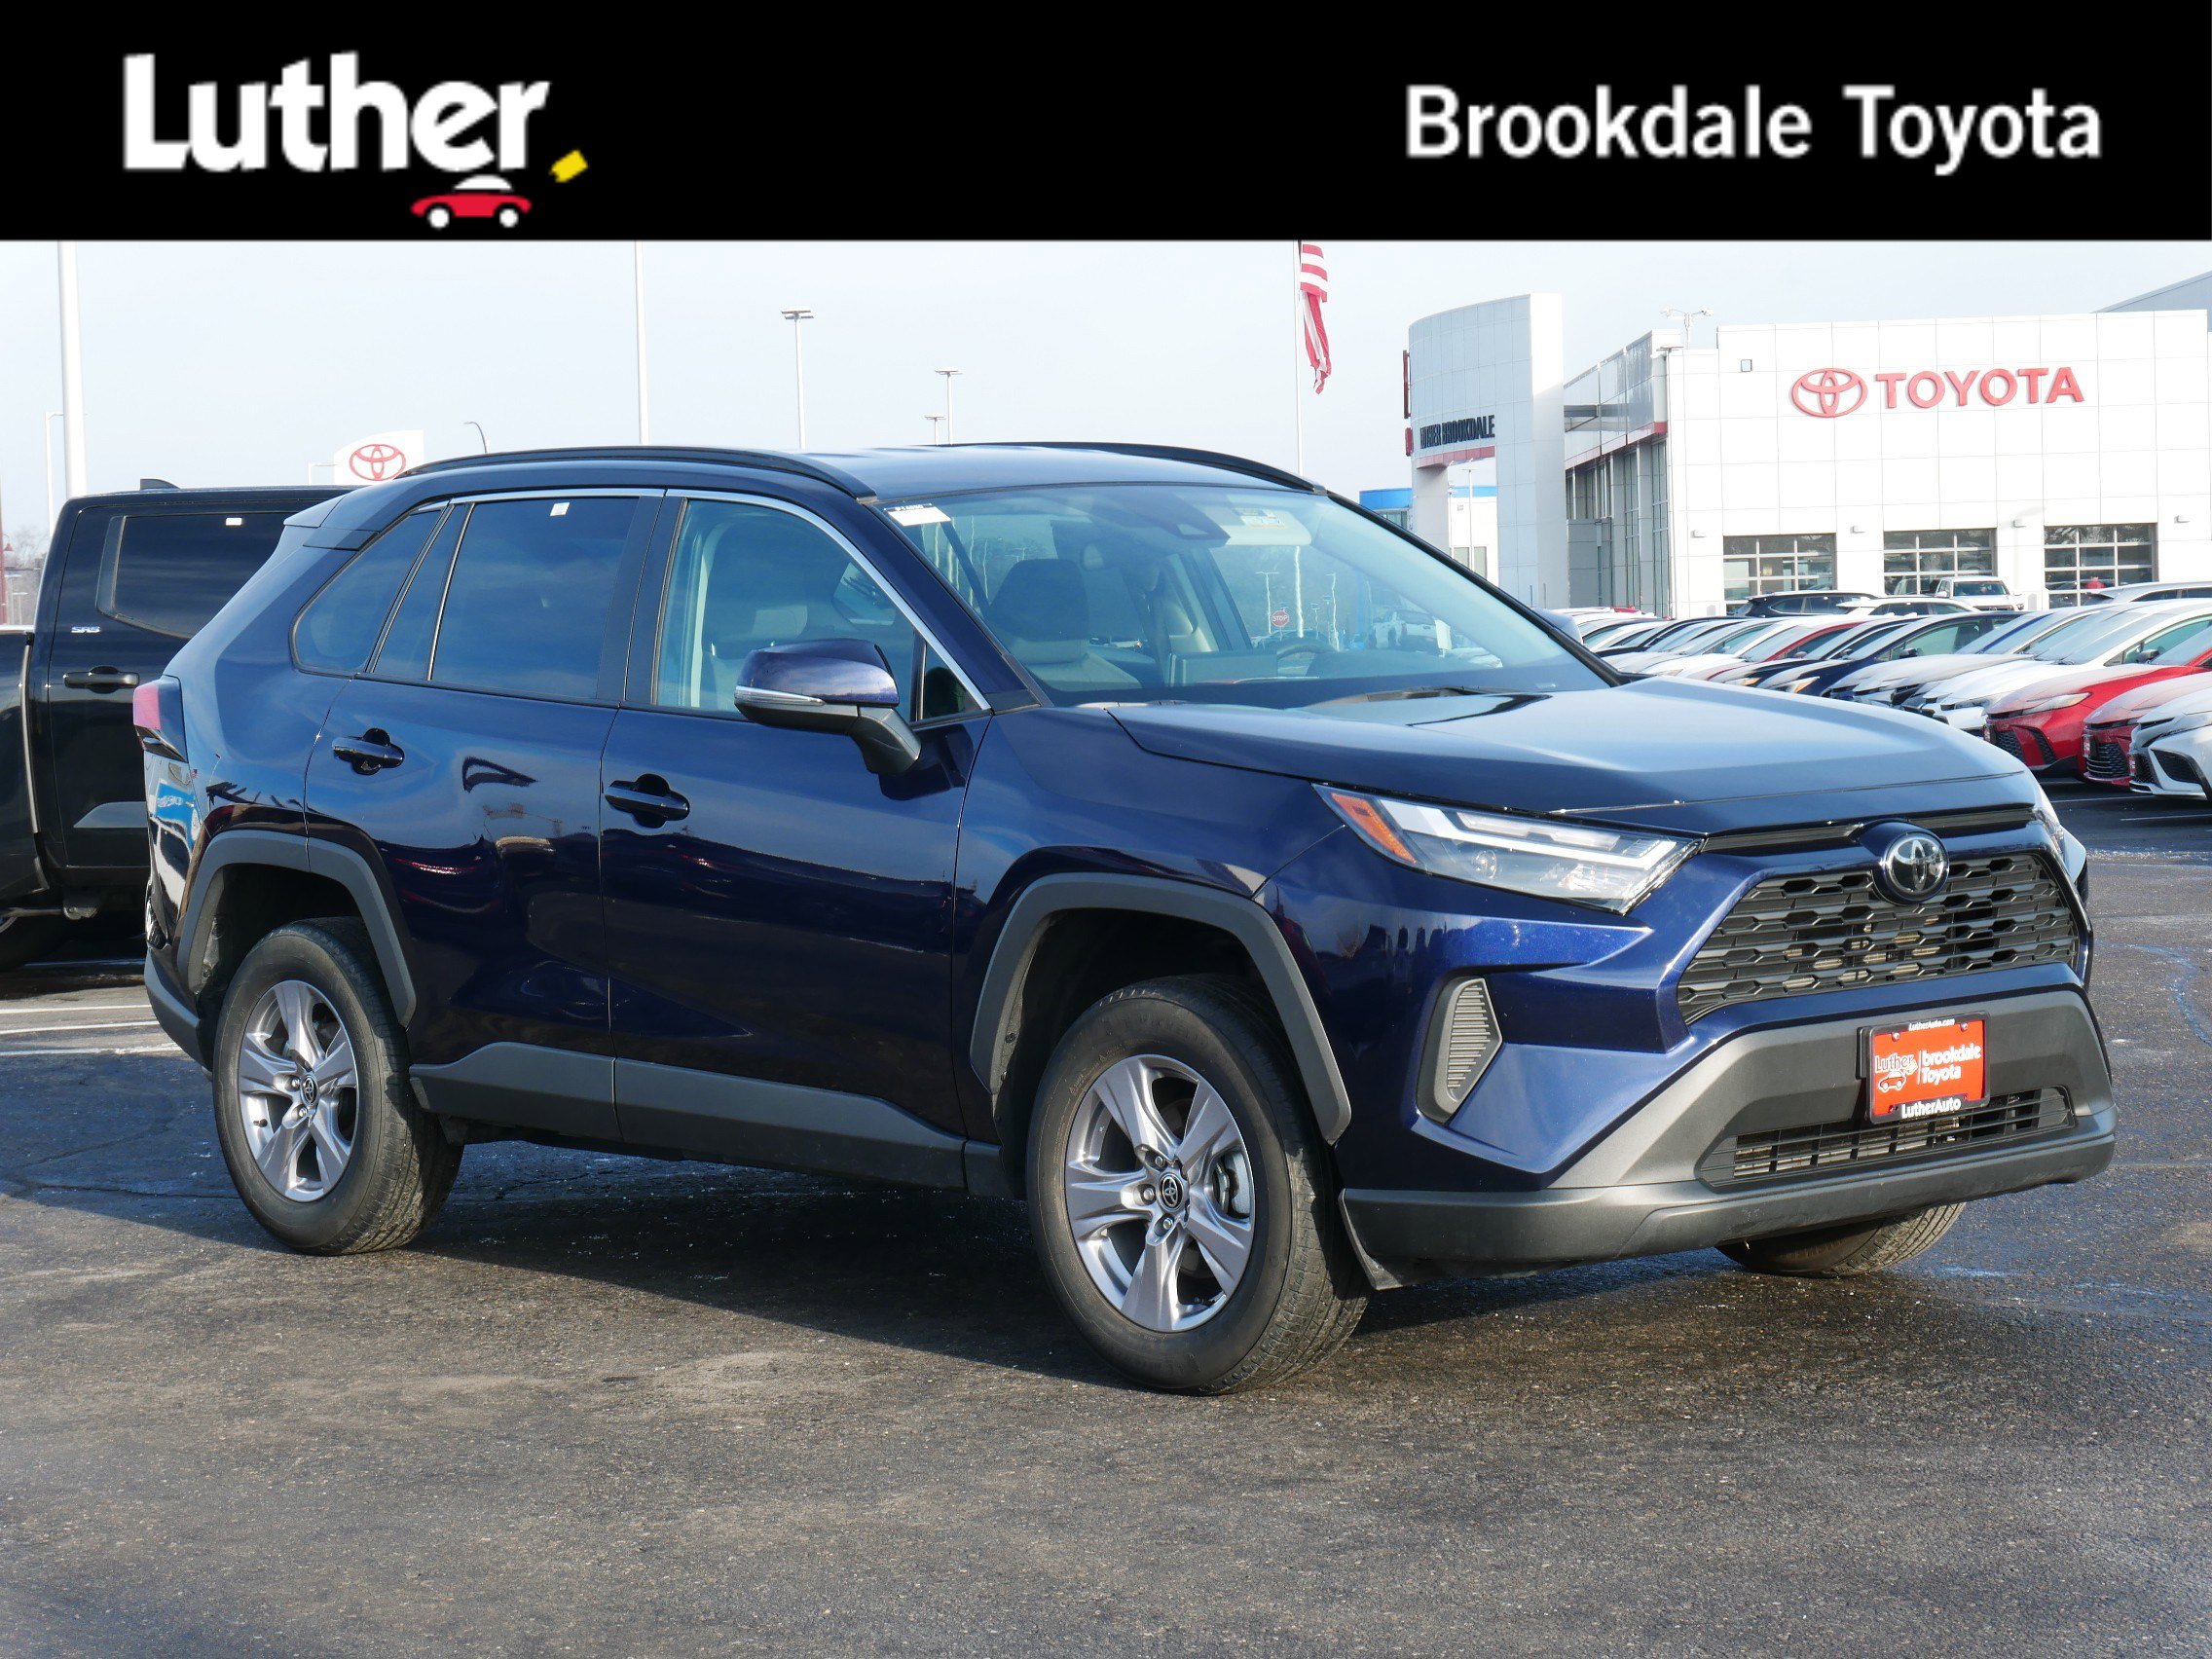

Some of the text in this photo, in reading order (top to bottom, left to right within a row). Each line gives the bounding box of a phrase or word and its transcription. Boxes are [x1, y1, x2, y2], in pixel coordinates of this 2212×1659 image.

[1875, 367, 2084, 409] TOYOTA
[1442, 415, 1494, 444] BROOKDALE
[1908, 1018, 1955, 1032] LutherAuto.com
[1874, 1052, 1915, 1073] Luther
[1922, 1044, 1981, 1066] brookdale
[1922, 1065, 1961, 1085] Toyota
[1901, 1096, 1962, 1119] LutherAuto
